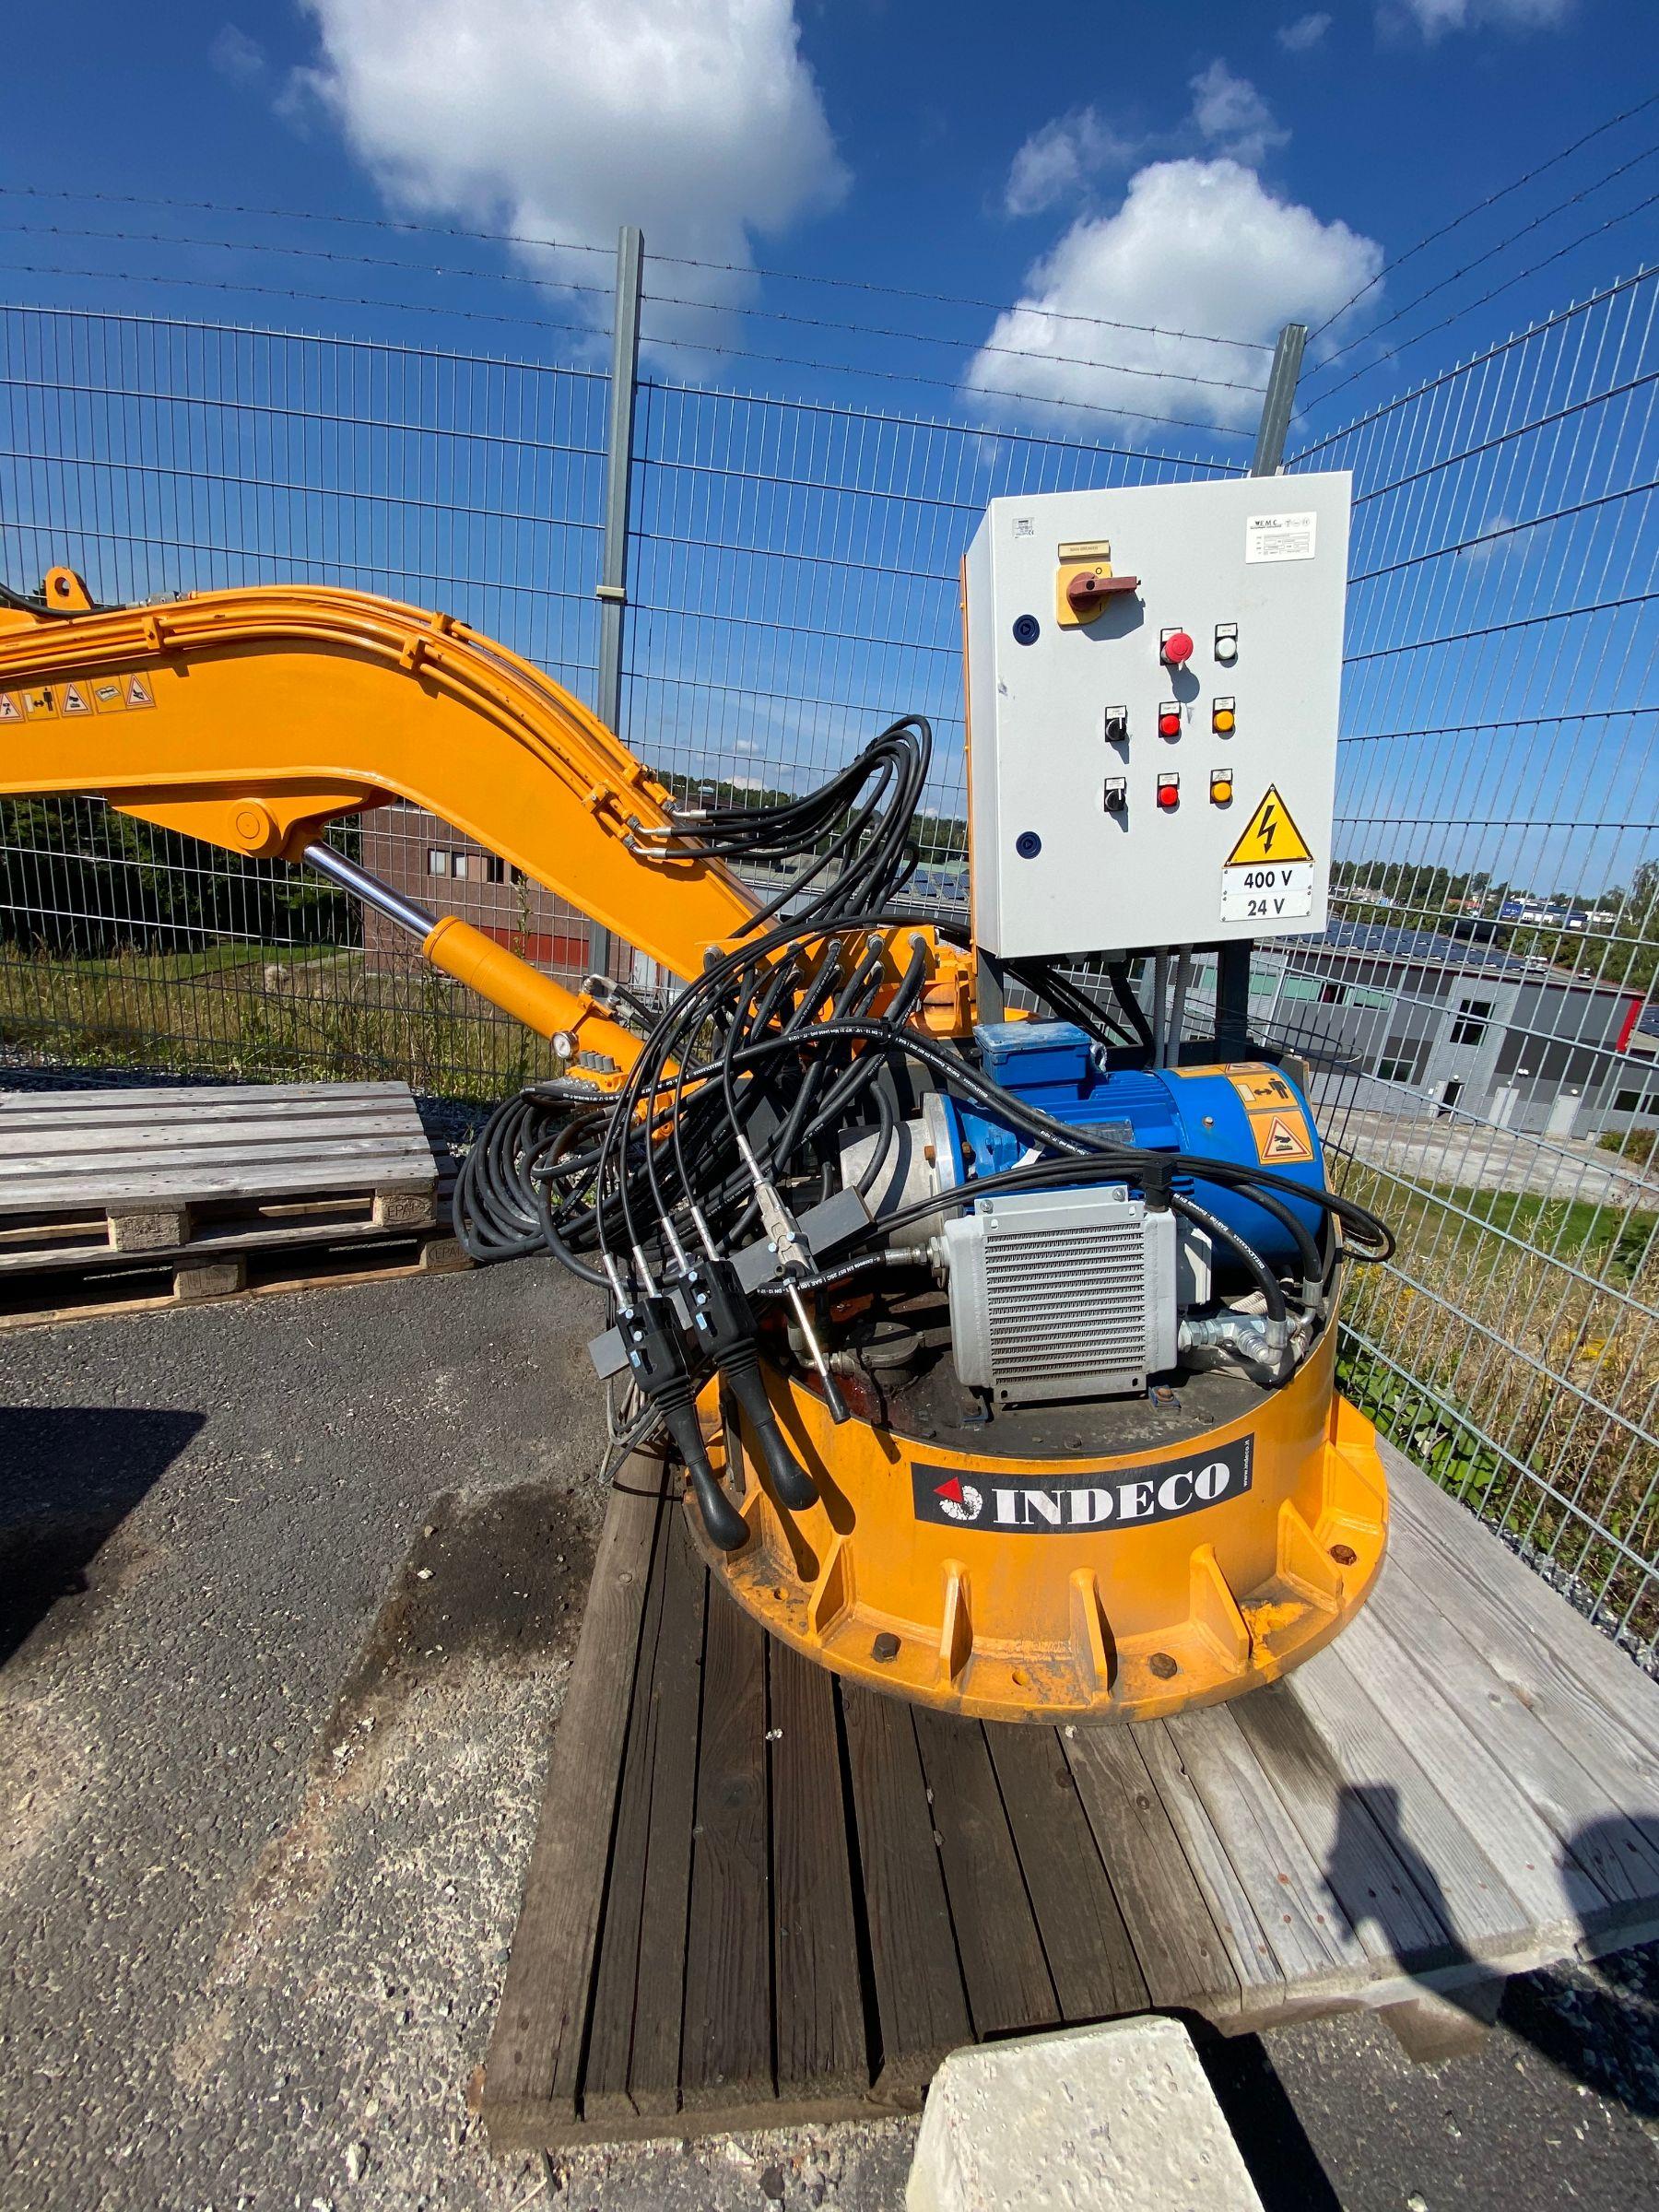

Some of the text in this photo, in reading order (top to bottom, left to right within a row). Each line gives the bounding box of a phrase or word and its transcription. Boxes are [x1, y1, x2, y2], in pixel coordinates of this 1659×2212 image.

[1244, 870, 1293, 888] 400 V
[1247, 898, 1285, 916] 24 V
[992, 1462, 1230, 1524] INDECO
